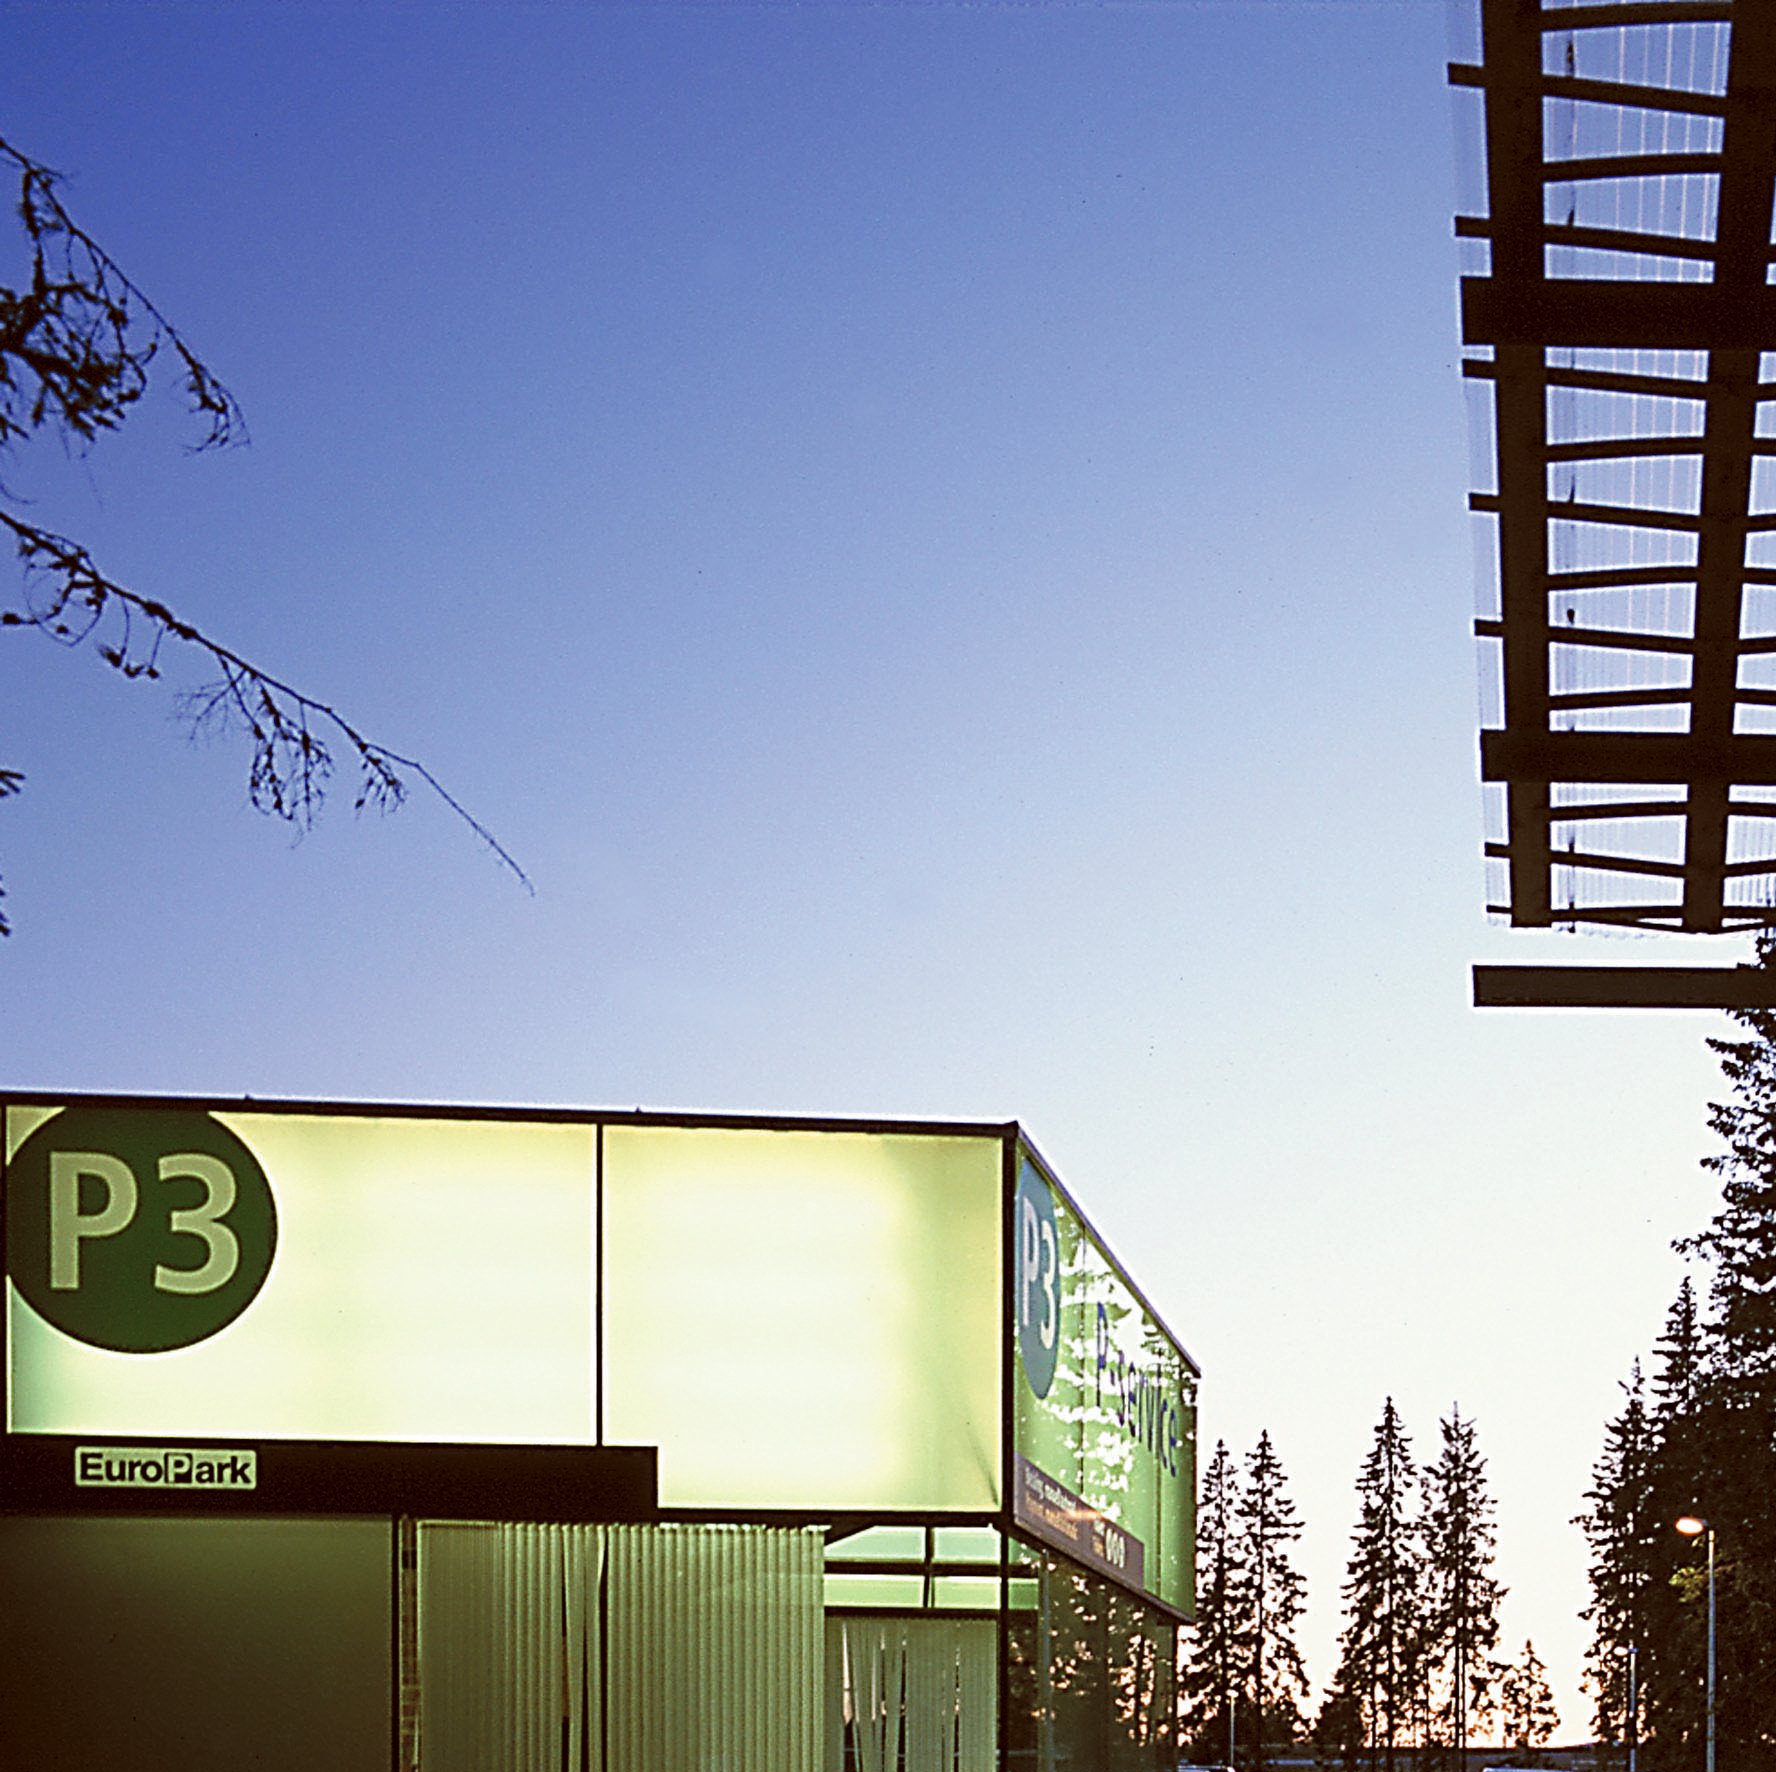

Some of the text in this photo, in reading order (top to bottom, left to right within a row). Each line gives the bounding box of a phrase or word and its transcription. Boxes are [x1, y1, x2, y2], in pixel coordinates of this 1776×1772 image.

[50, 1151, 240, 1294] P3
[1022, 1195, 1057, 1350] P3
[79, 1451, 252, 1485] EuroPark
